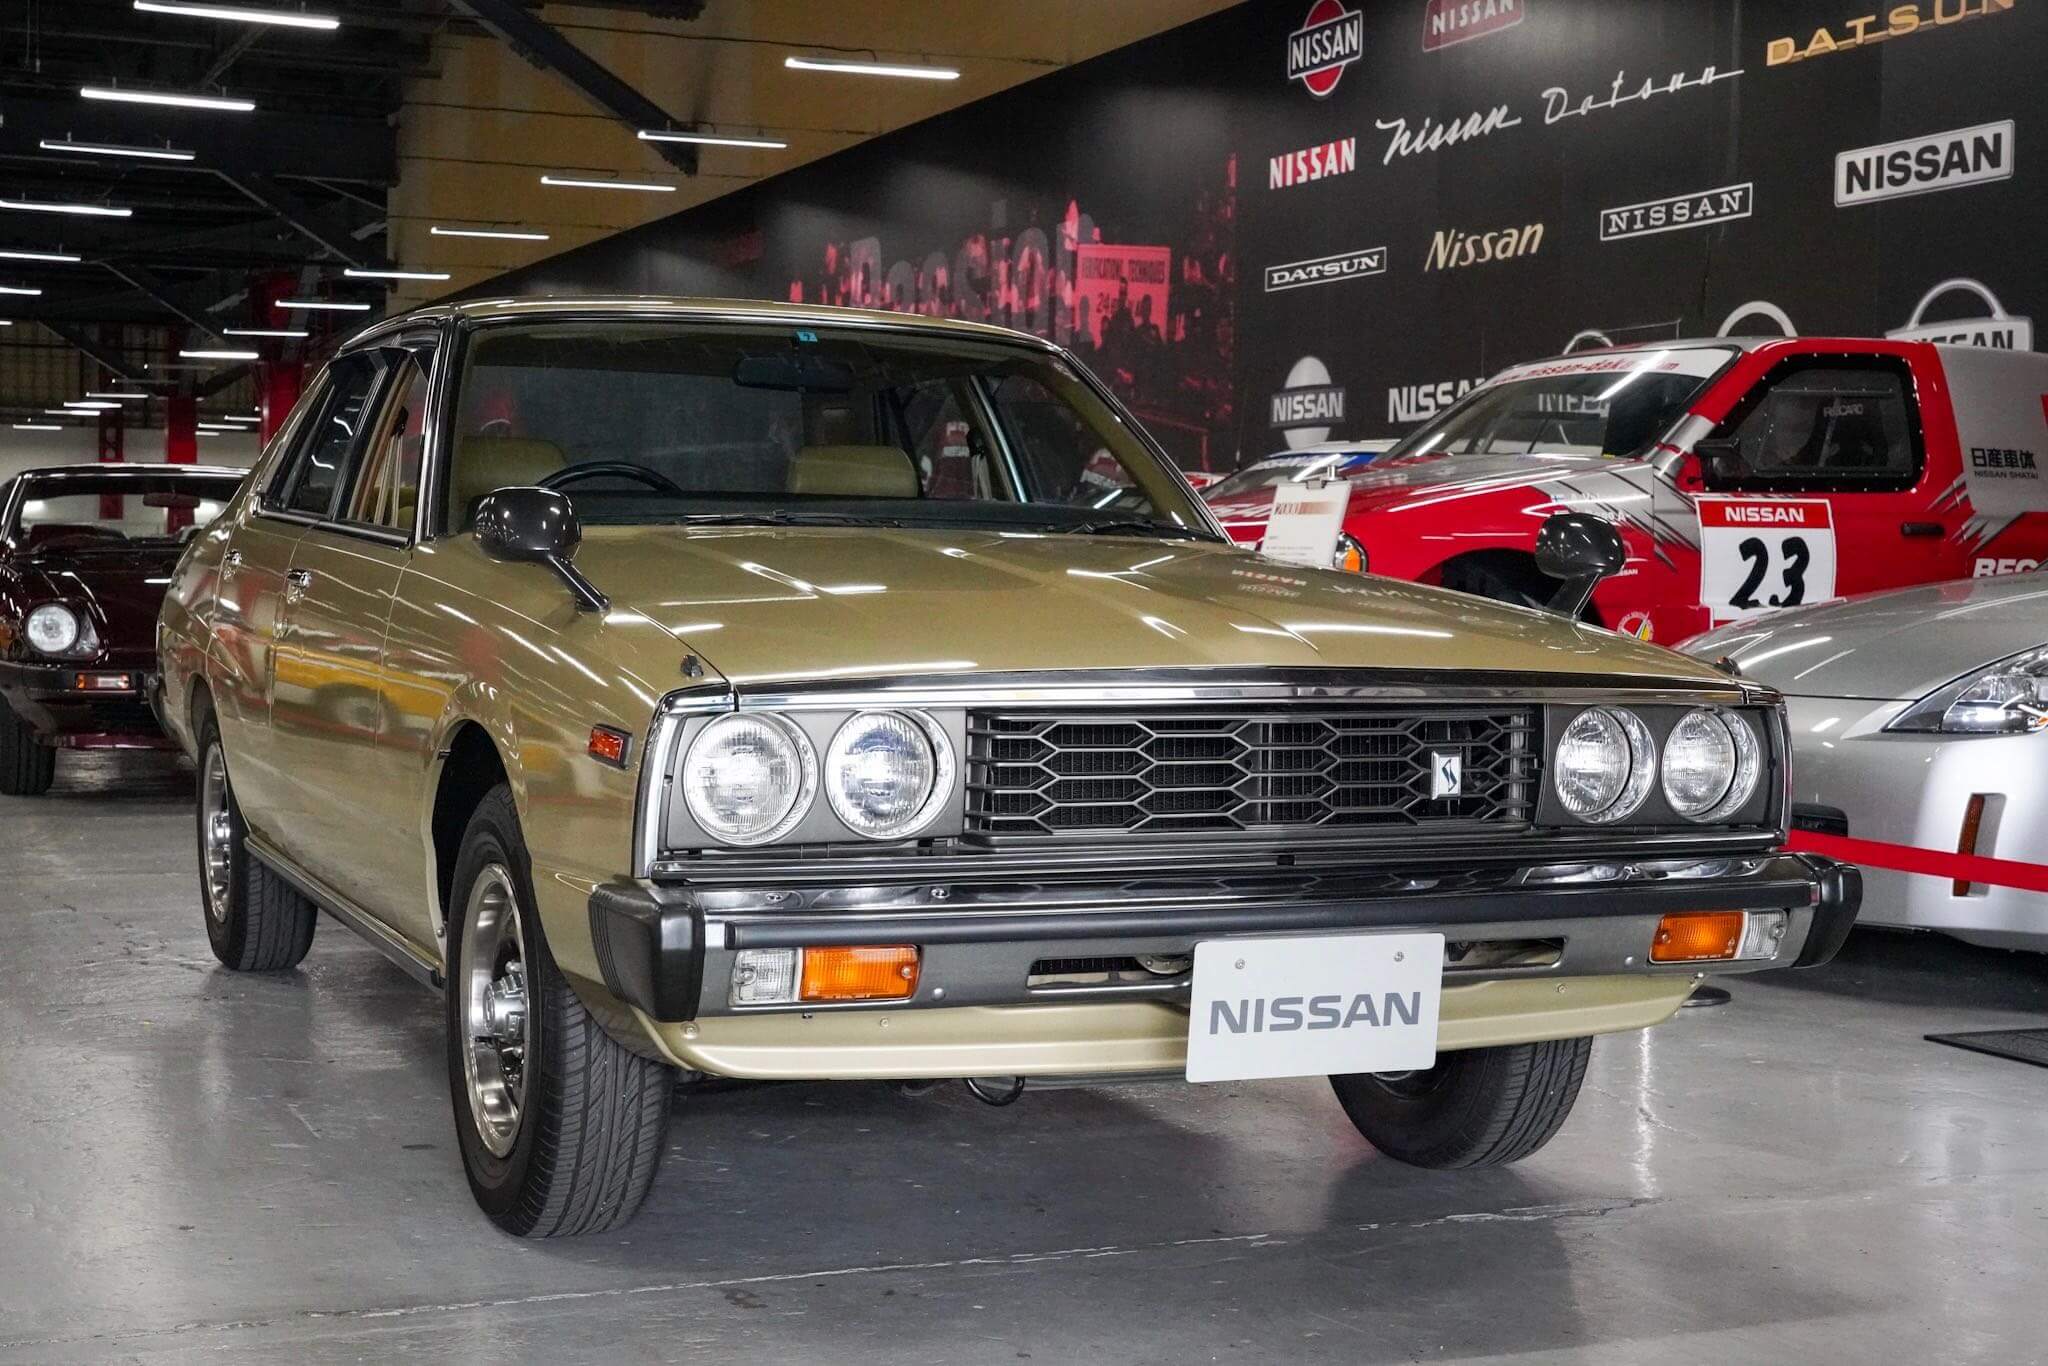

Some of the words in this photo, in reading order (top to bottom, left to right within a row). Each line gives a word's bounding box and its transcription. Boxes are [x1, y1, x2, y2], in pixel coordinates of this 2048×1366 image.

[1292, 20, 1359, 70] NISSAN
[1541, 66, 1744, 124] Datsun
[1270, 137, 1356, 189] NISSAN
[1845, 132, 2003, 195] NISSAN
[1607, 190, 1743, 234] NISSAN
[1271, 254, 1380, 285] DATSUN
[1424, 222, 1544, 272] Nissan
[1272, 392, 1344, 422] NISSAN
[1388, 377, 1486, 424] NISSA
[1974, 471, 2007, 479] NISSAN
[1725, 506, 1804, 522] NISSAN
[1729, 537, 1810, 609] 23
[1209, 991, 1421, 1035] NISSAN
